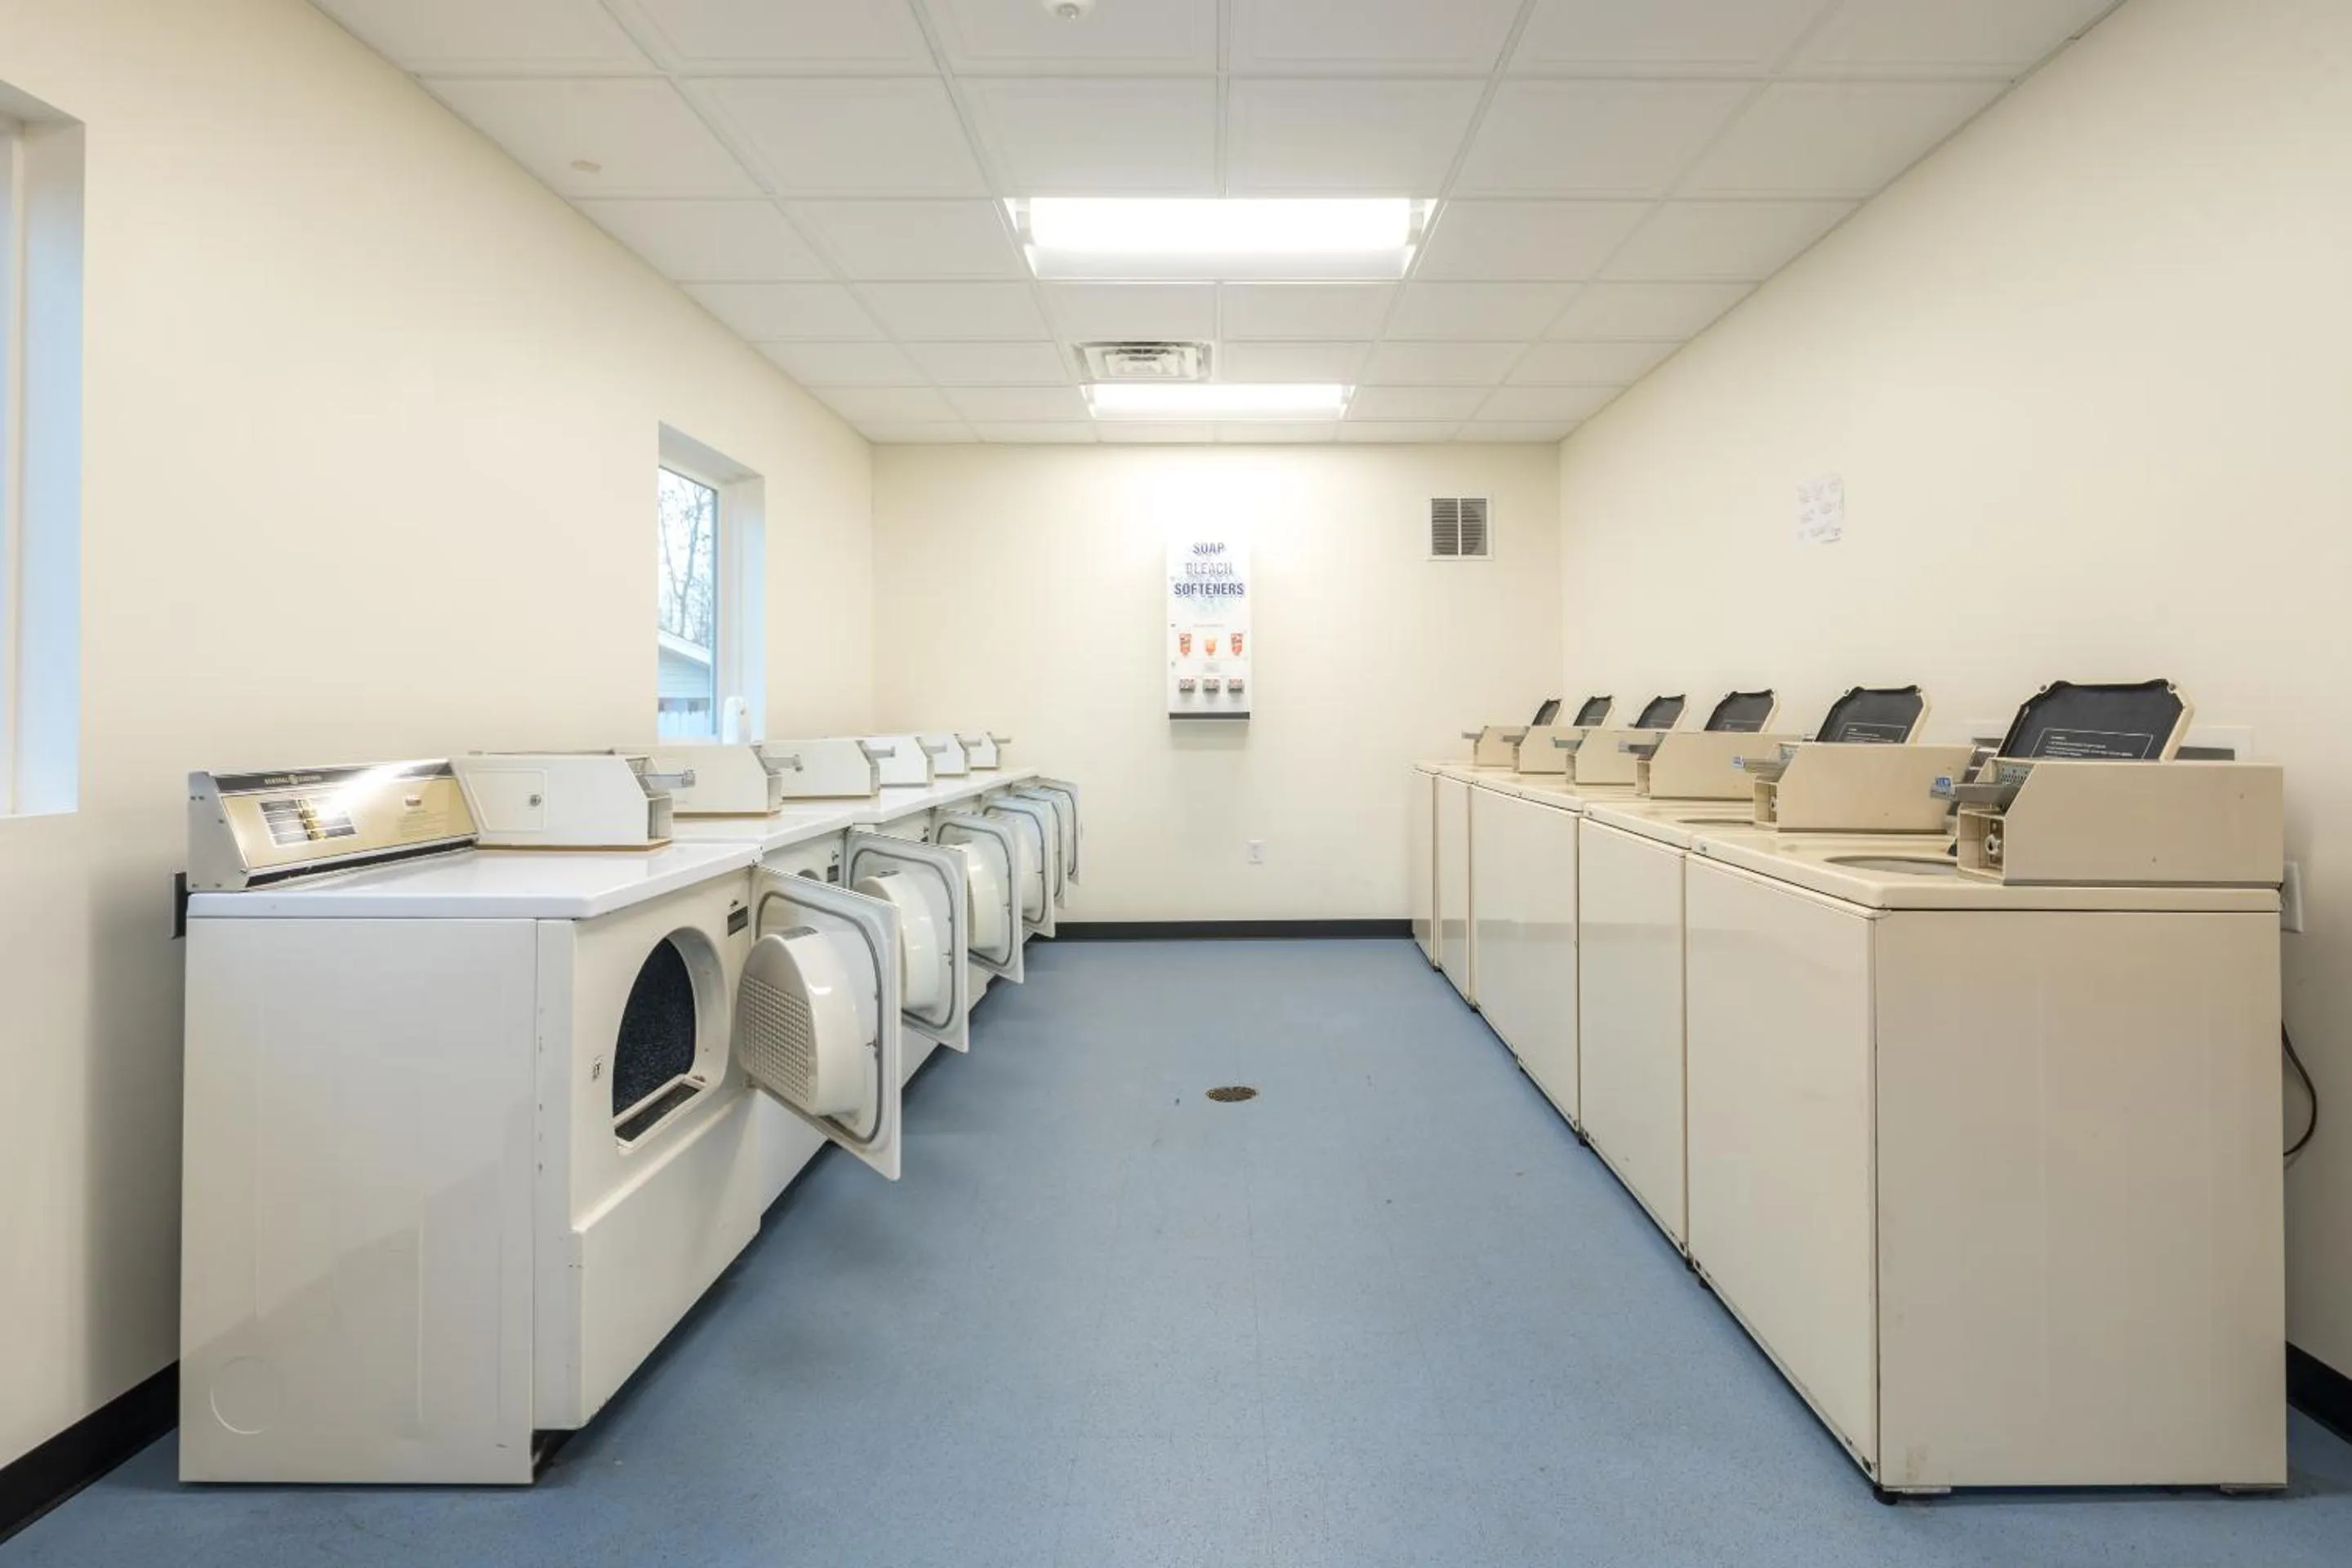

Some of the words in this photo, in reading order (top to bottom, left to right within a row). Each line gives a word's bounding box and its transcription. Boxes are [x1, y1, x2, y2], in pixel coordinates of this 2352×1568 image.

[1192, 542, 1225, 555] SOAP
[1185, 562, 1232, 575] BLEACH
[1174, 583, 1244, 595] SOFTENERS
